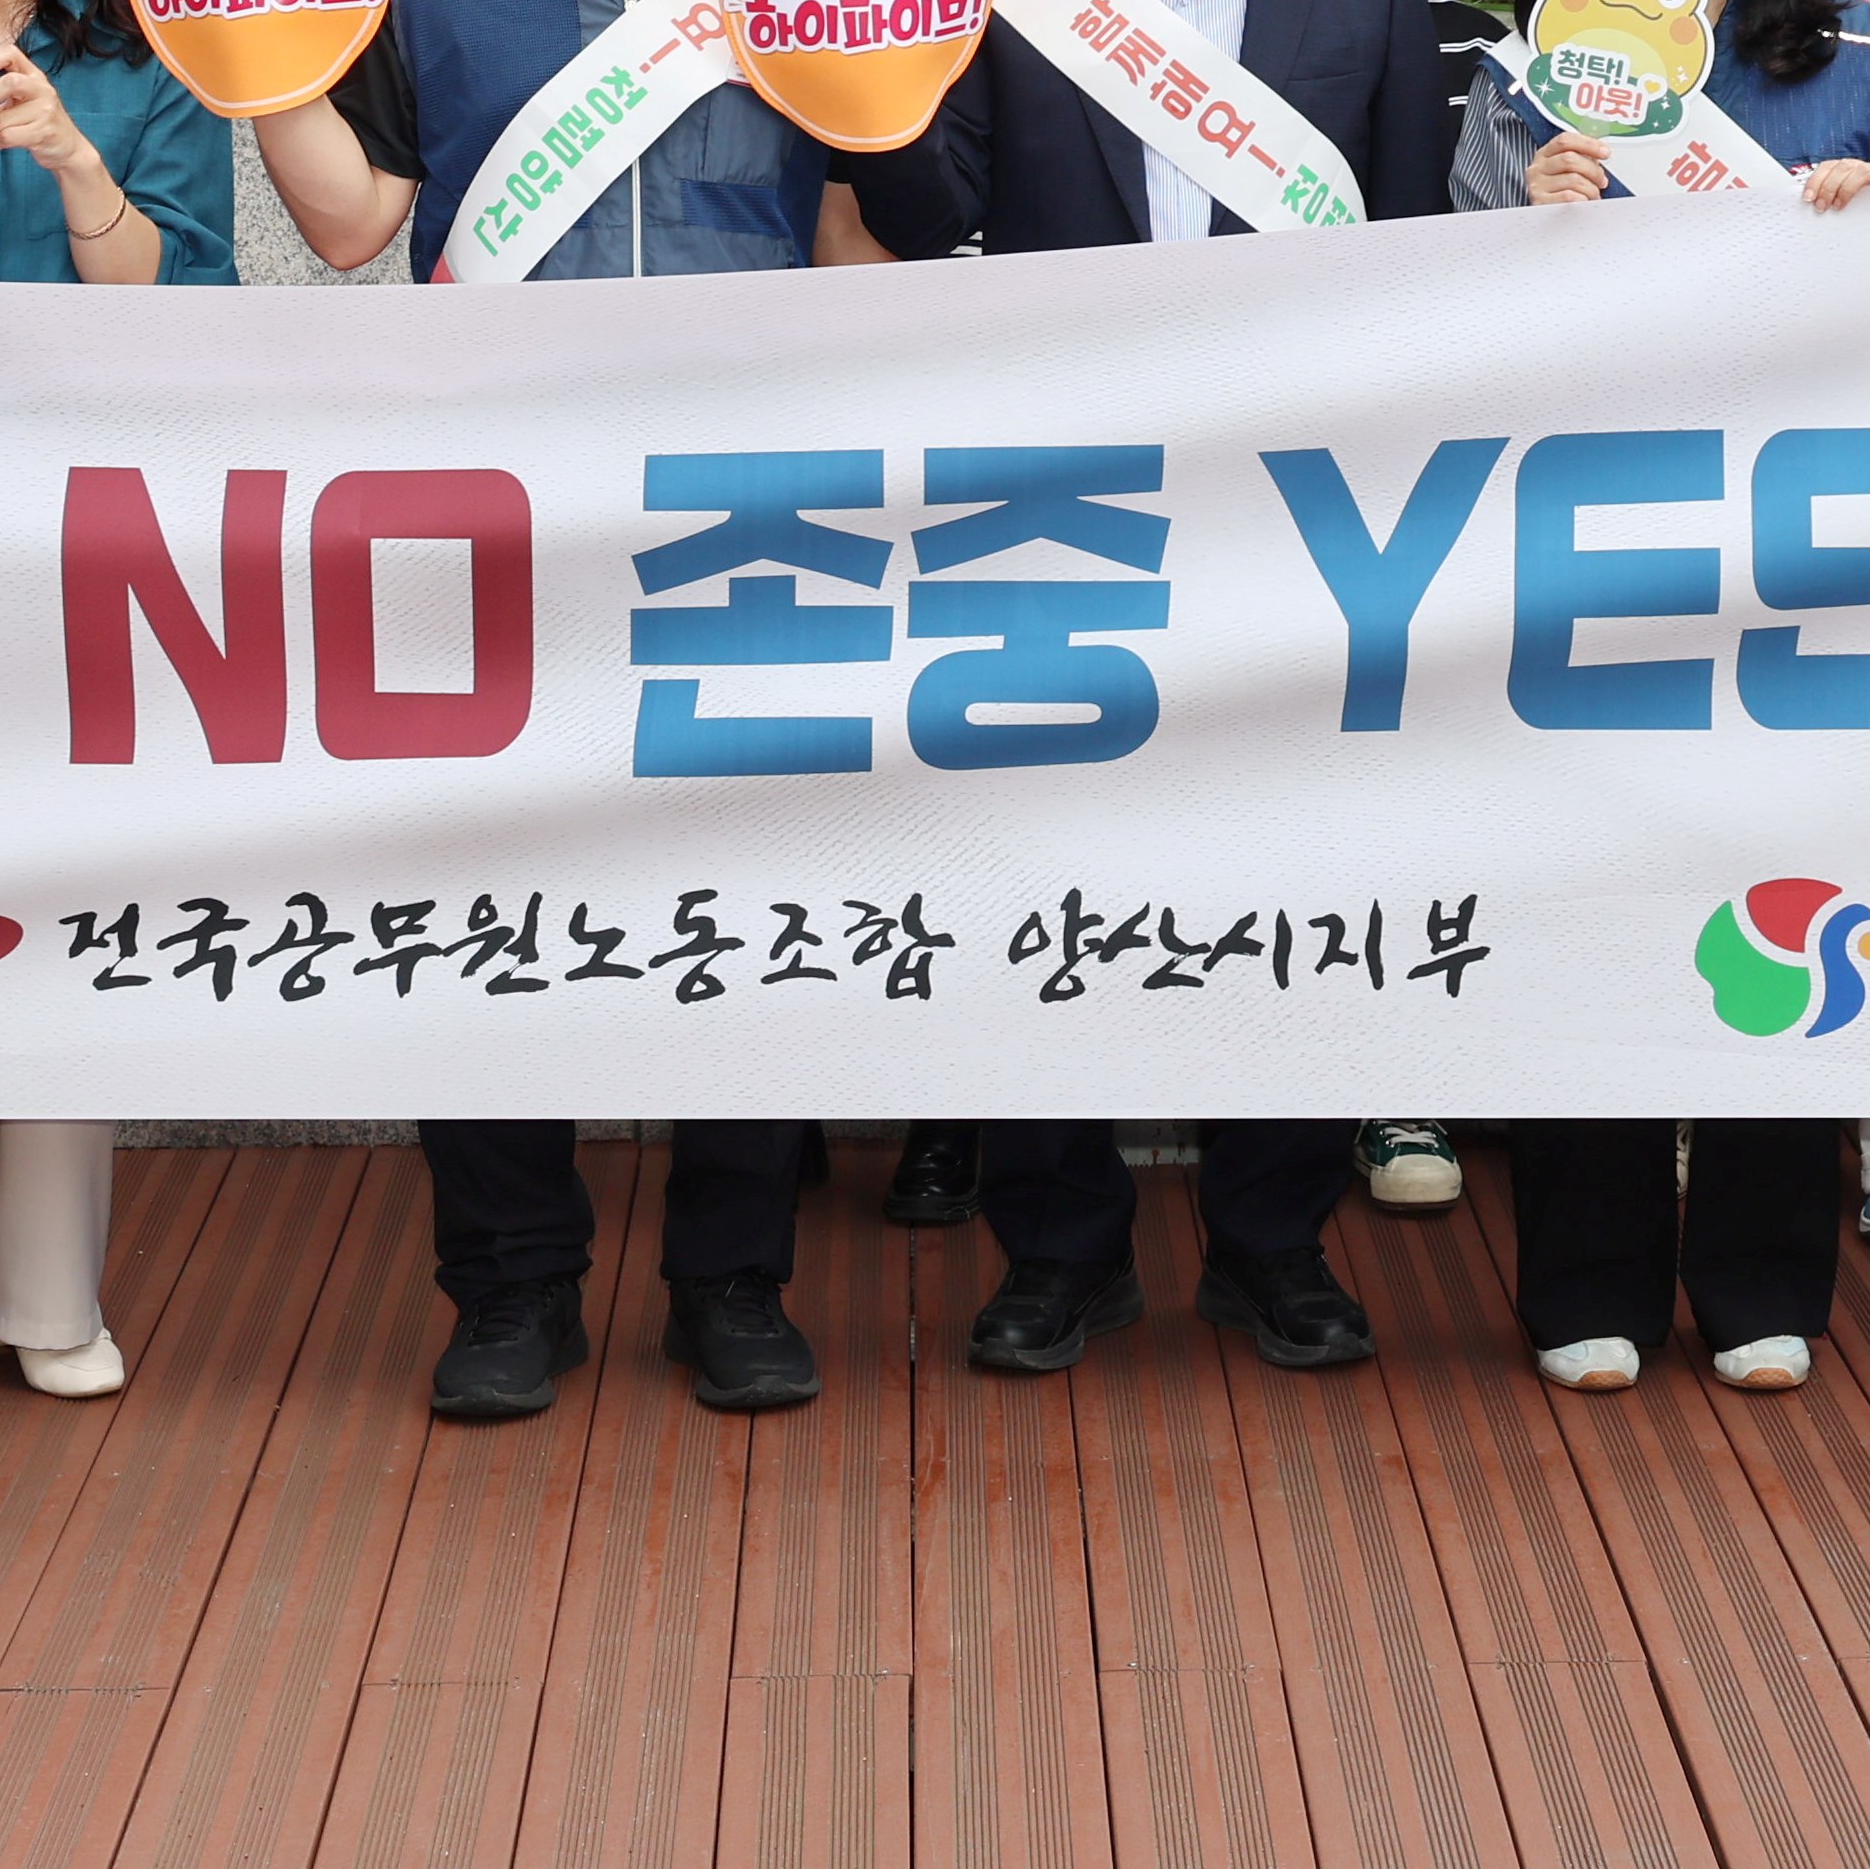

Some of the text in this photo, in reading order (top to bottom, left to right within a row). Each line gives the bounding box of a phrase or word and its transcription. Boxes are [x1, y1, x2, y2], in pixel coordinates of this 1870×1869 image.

[1558, 49, 1624, 85] 청탁!
[1576, 82, 1643, 118] 아웃!
[63, 468, 534, 765] NO
[631, 446, 1171, 778] 존중
[58, 888, 1491, 1004] 전국공무원노동조합 양산시지부
